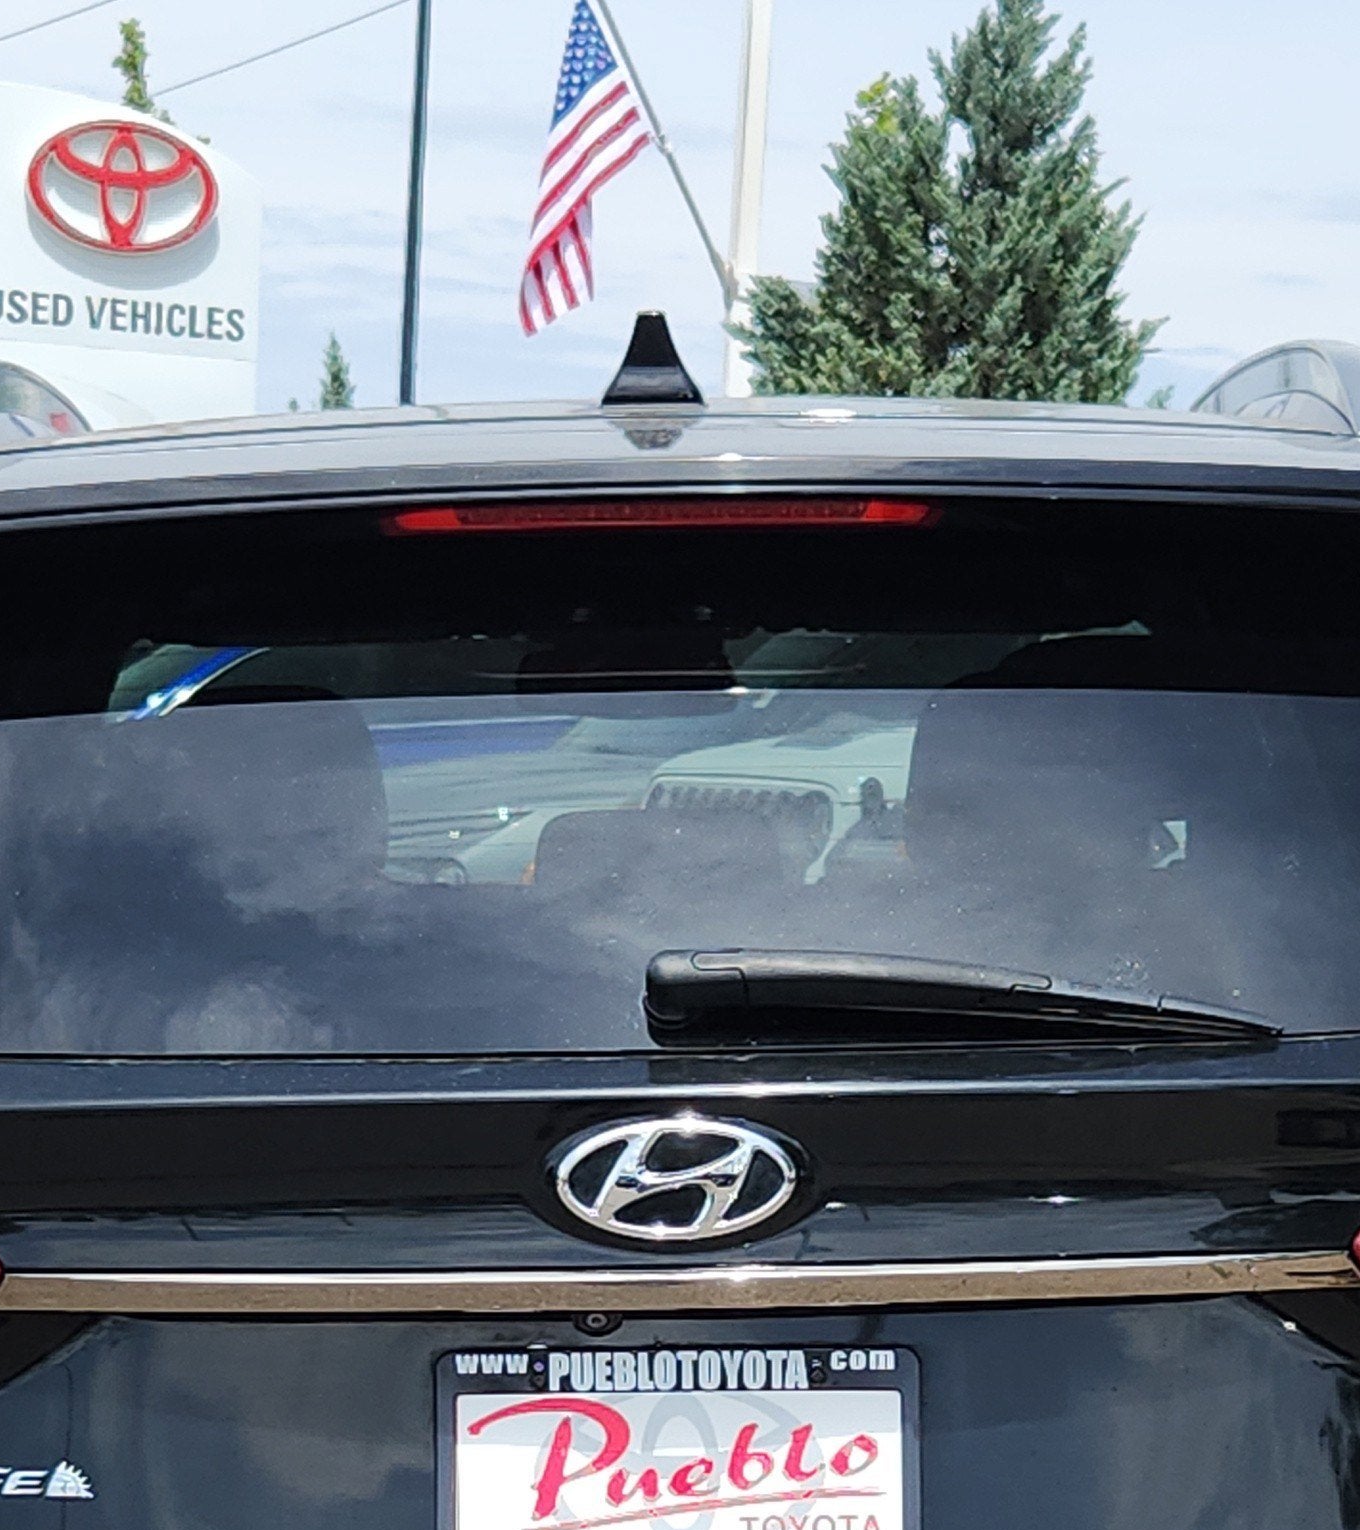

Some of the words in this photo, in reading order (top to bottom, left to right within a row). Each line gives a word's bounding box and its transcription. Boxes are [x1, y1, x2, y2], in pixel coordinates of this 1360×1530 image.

[85, 295, 245, 342] VEHICLES
[548, 1351, 809, 1391] PUEBLOTOYOTA
[467, 1397, 879, 1521] Pueblo
